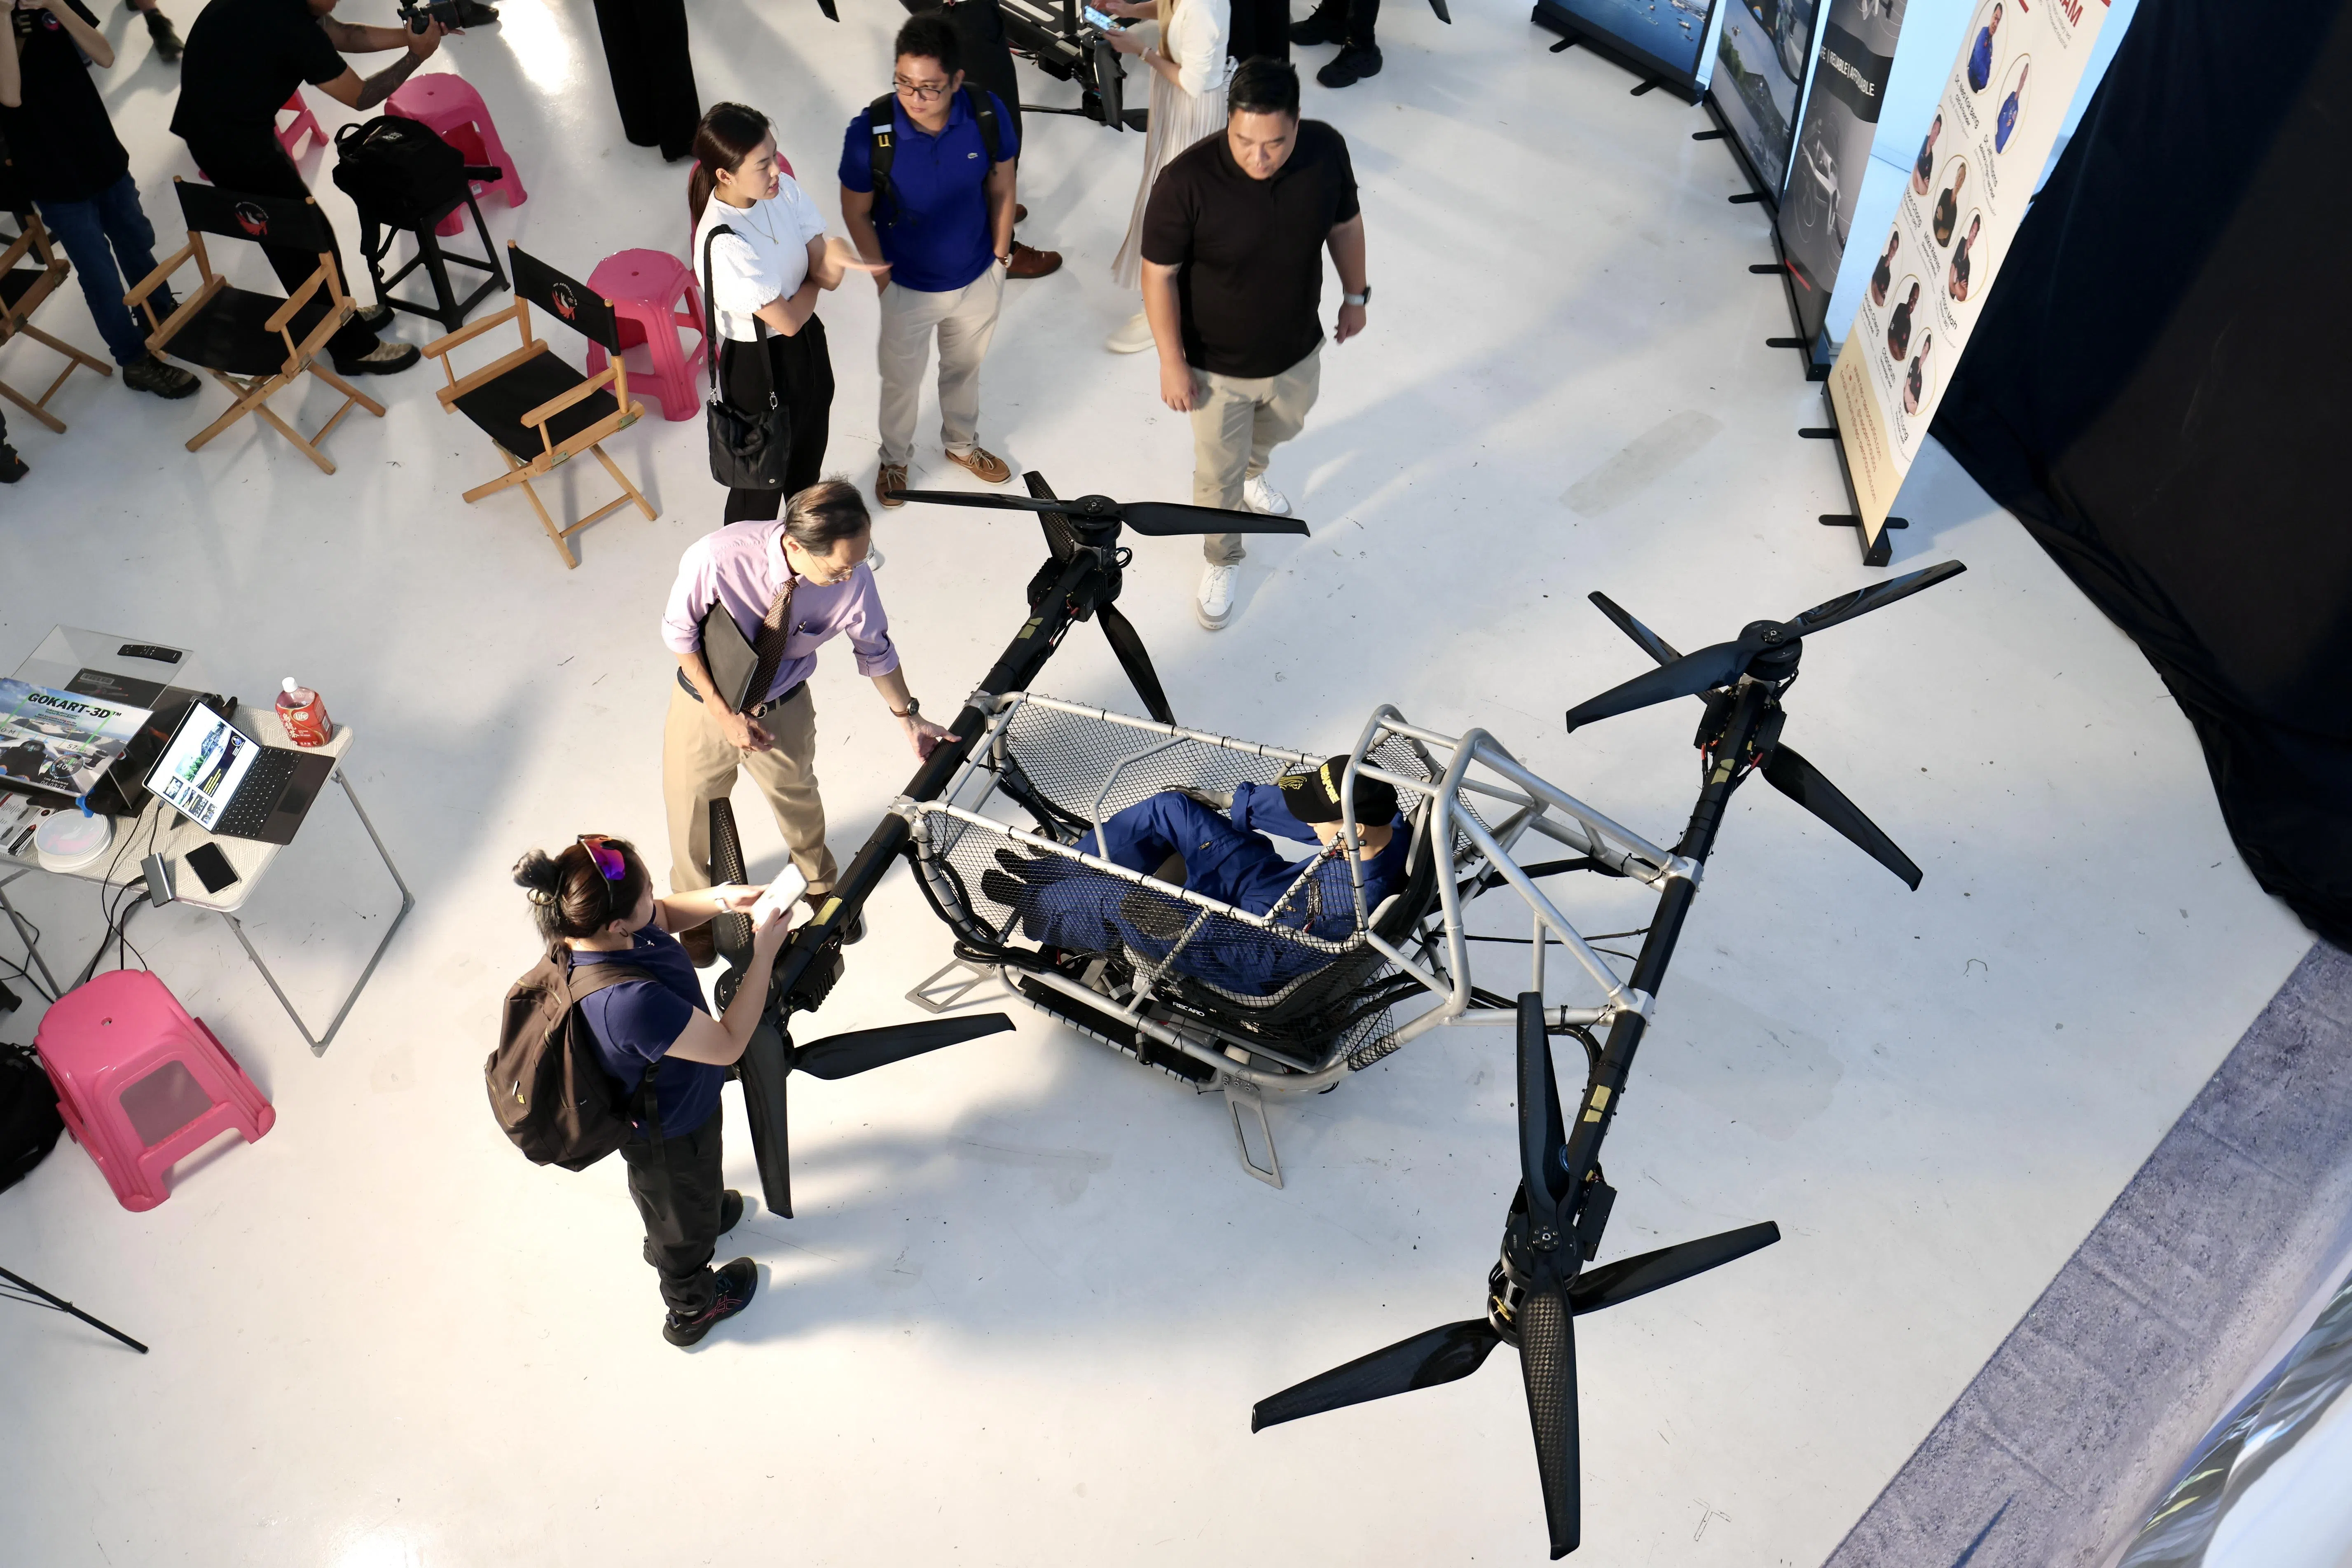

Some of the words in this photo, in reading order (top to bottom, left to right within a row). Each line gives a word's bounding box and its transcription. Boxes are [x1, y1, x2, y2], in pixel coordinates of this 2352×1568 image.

[2059, 0, 2083, 27] AM
[1830, 51, 1848, 75] RELIABLE
[1849, 66, 1875, 96] AFFORDABLE
[1958, 82, 1966, 101] Neo
[1968, 106, 1980, 131] Beng
[1961, 105, 1971, 128] Founder
[1911, 199, 1923, 229] Chong
[1923, 229, 1932, 251] Mike
[1930, 245, 1941, 274] Reeves
[1941, 284, 1949, 315] Dickson
[1946, 310, 1958, 331] Mah
[1870, 311, 1880, 338] Cheng
[1879, 355, 1888, 381] Technology
[1881, 344, 1896, 386] Chandruth
[1852, 361, 1883, 462] www.neo-aeronautics.com
[1856, 405, 1878, 475] @neoaeronautics
[283, 713, 300, 738] 烏龍茶
[56, 763, 75, 772] 40%
[1173, 1002, 1205, 1016] RECARO
